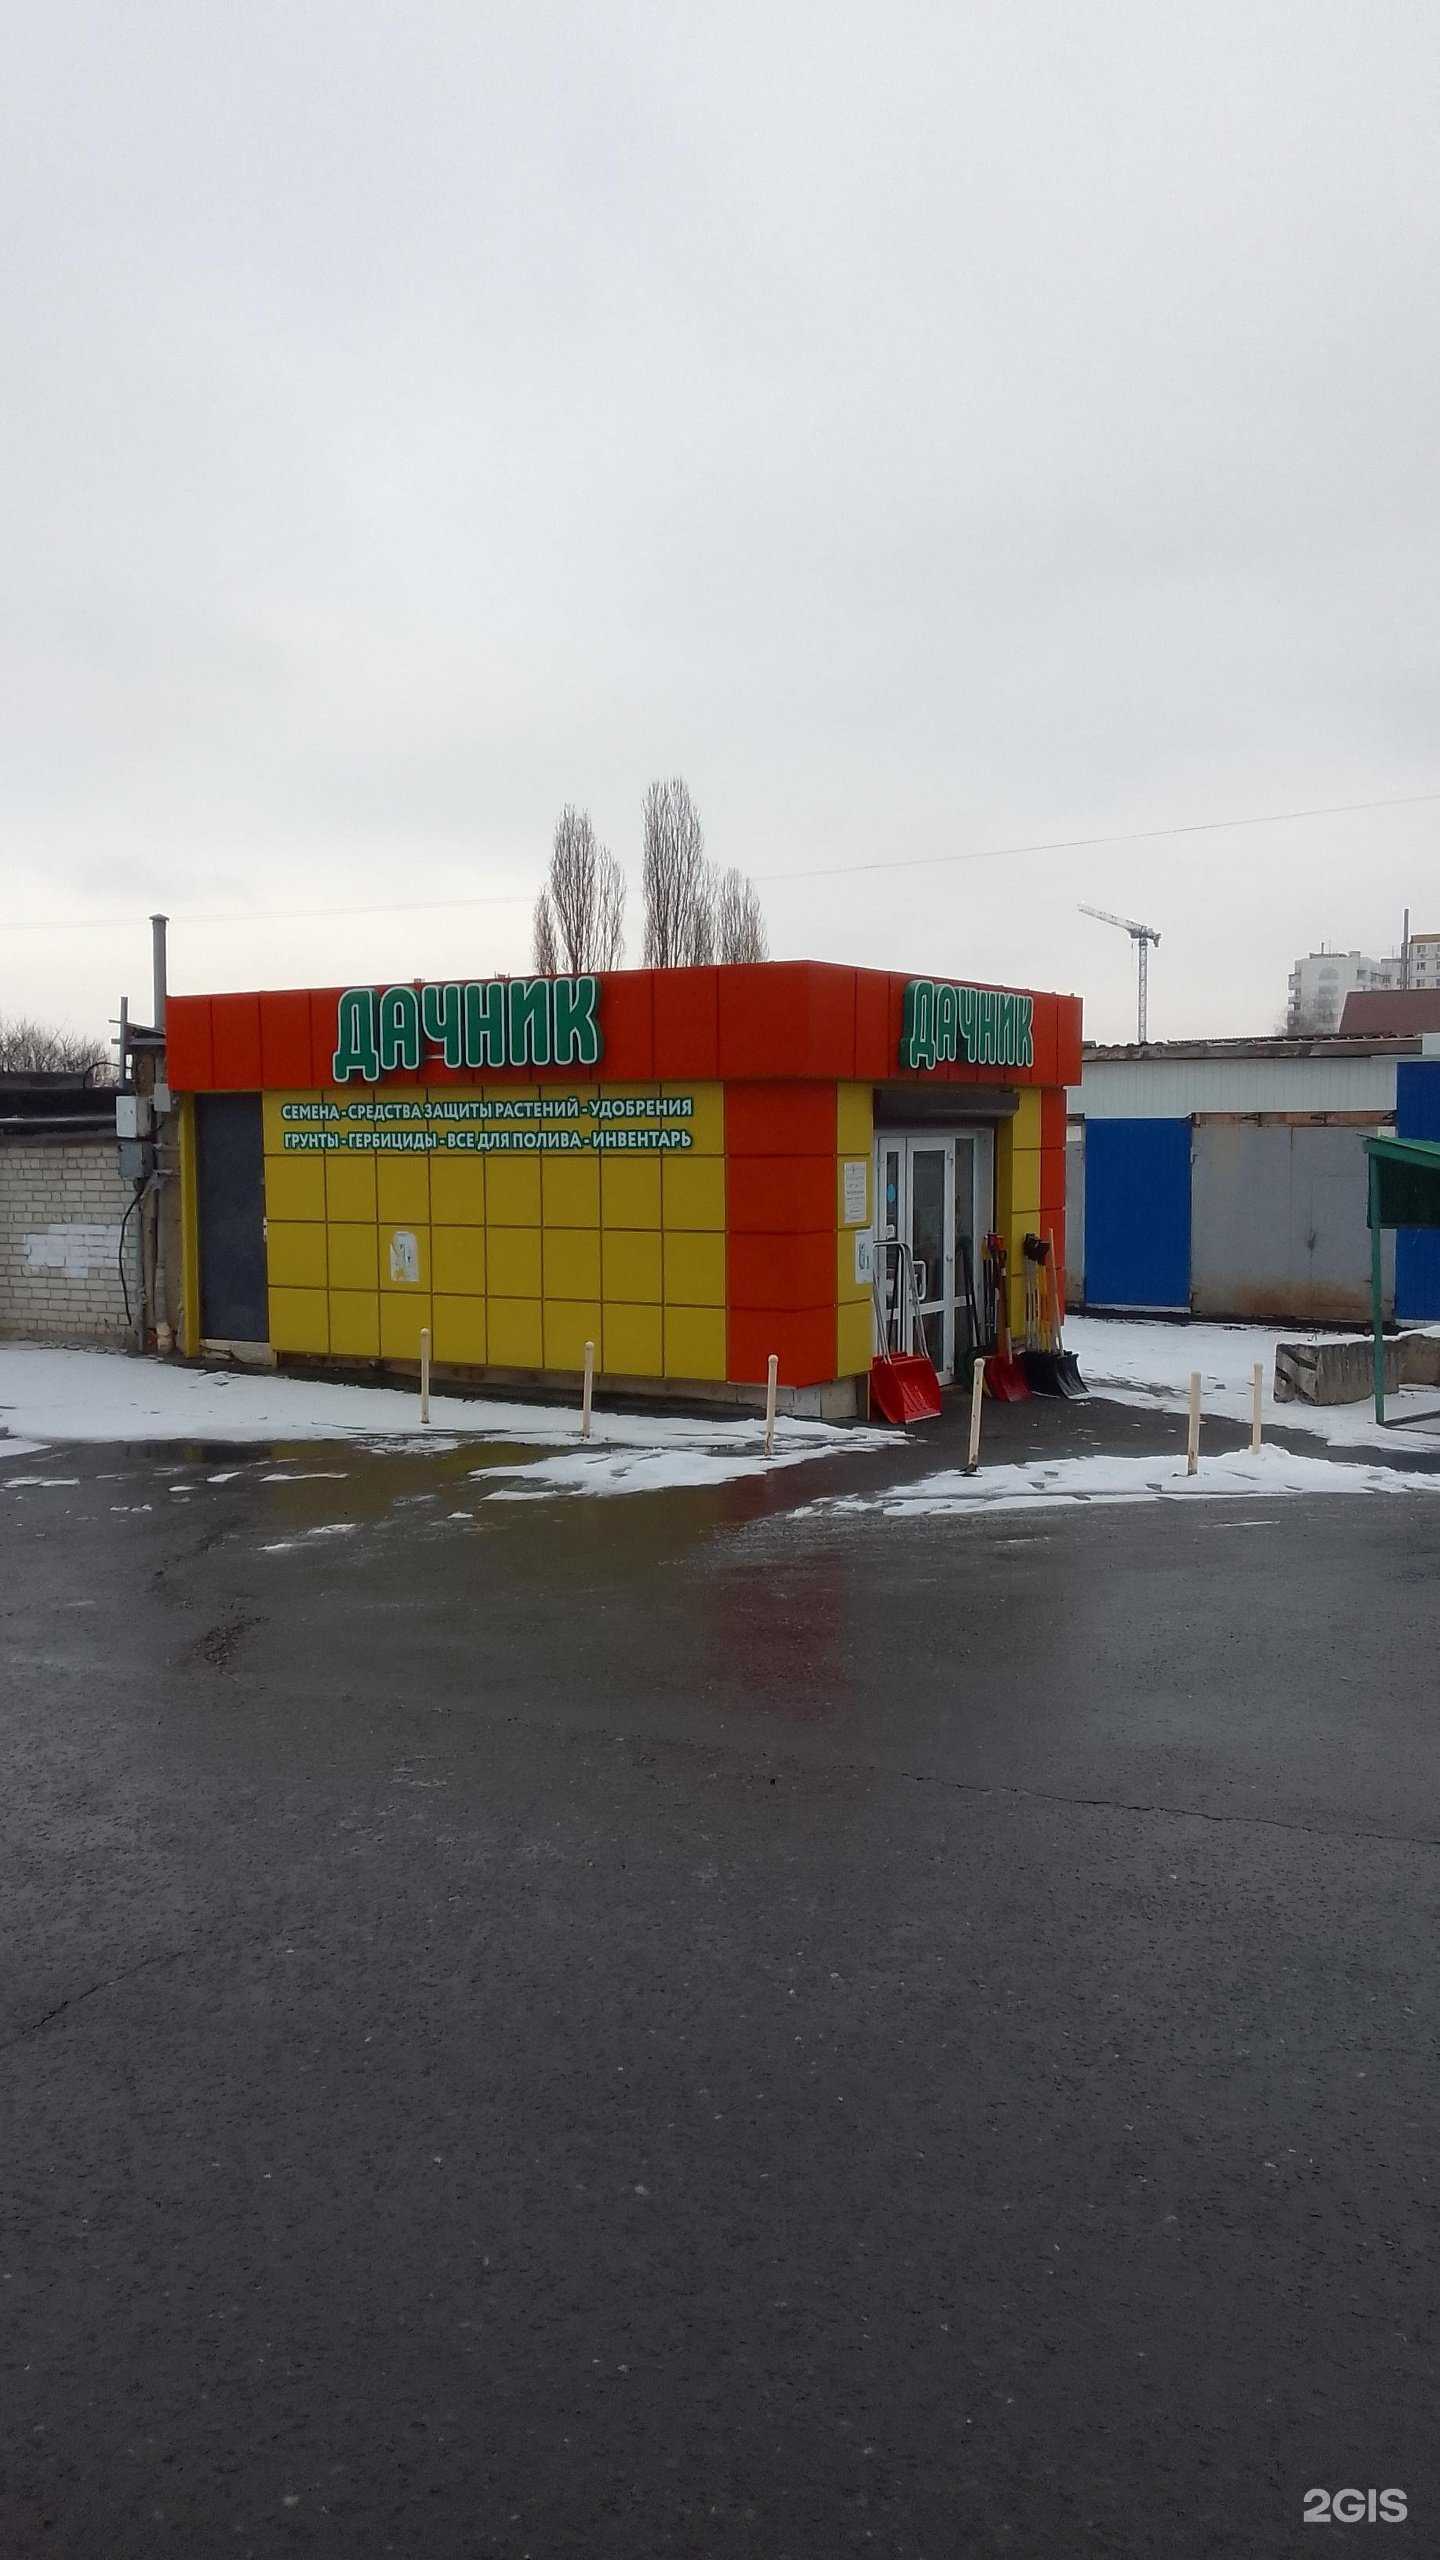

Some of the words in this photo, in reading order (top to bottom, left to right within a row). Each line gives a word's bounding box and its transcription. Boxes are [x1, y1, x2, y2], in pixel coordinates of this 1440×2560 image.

[332, 976, 599, 1083] ДАЧНИК
[909, 980, 1034, 1070] ДАЧНИК
[282, 1103, 340, 1120] СЕМЕНА
[348, 1103, 422, 1121] СРЕДСТВА
[424, 1102, 492, 1120] ЗАЩИТЫ
[495, 1097, 579, 1118] РАСТЕНИЙ
[589, 1099, 692, 1118] УДОБРЕНИЯ
[284, 1133, 339, 1148] ГРУНТЫ
[348, 1132, 437, 1150] ГЕРБИЦИДЫ
[447, 1132, 475, 1148] ВСЕ
[477, 1132, 510, 1150] ДЛЯ
[513, 1131, 582, 1148] ПОЛИВА
[592, 1131, 692, 1148] ИНВЕНТАРЬ
